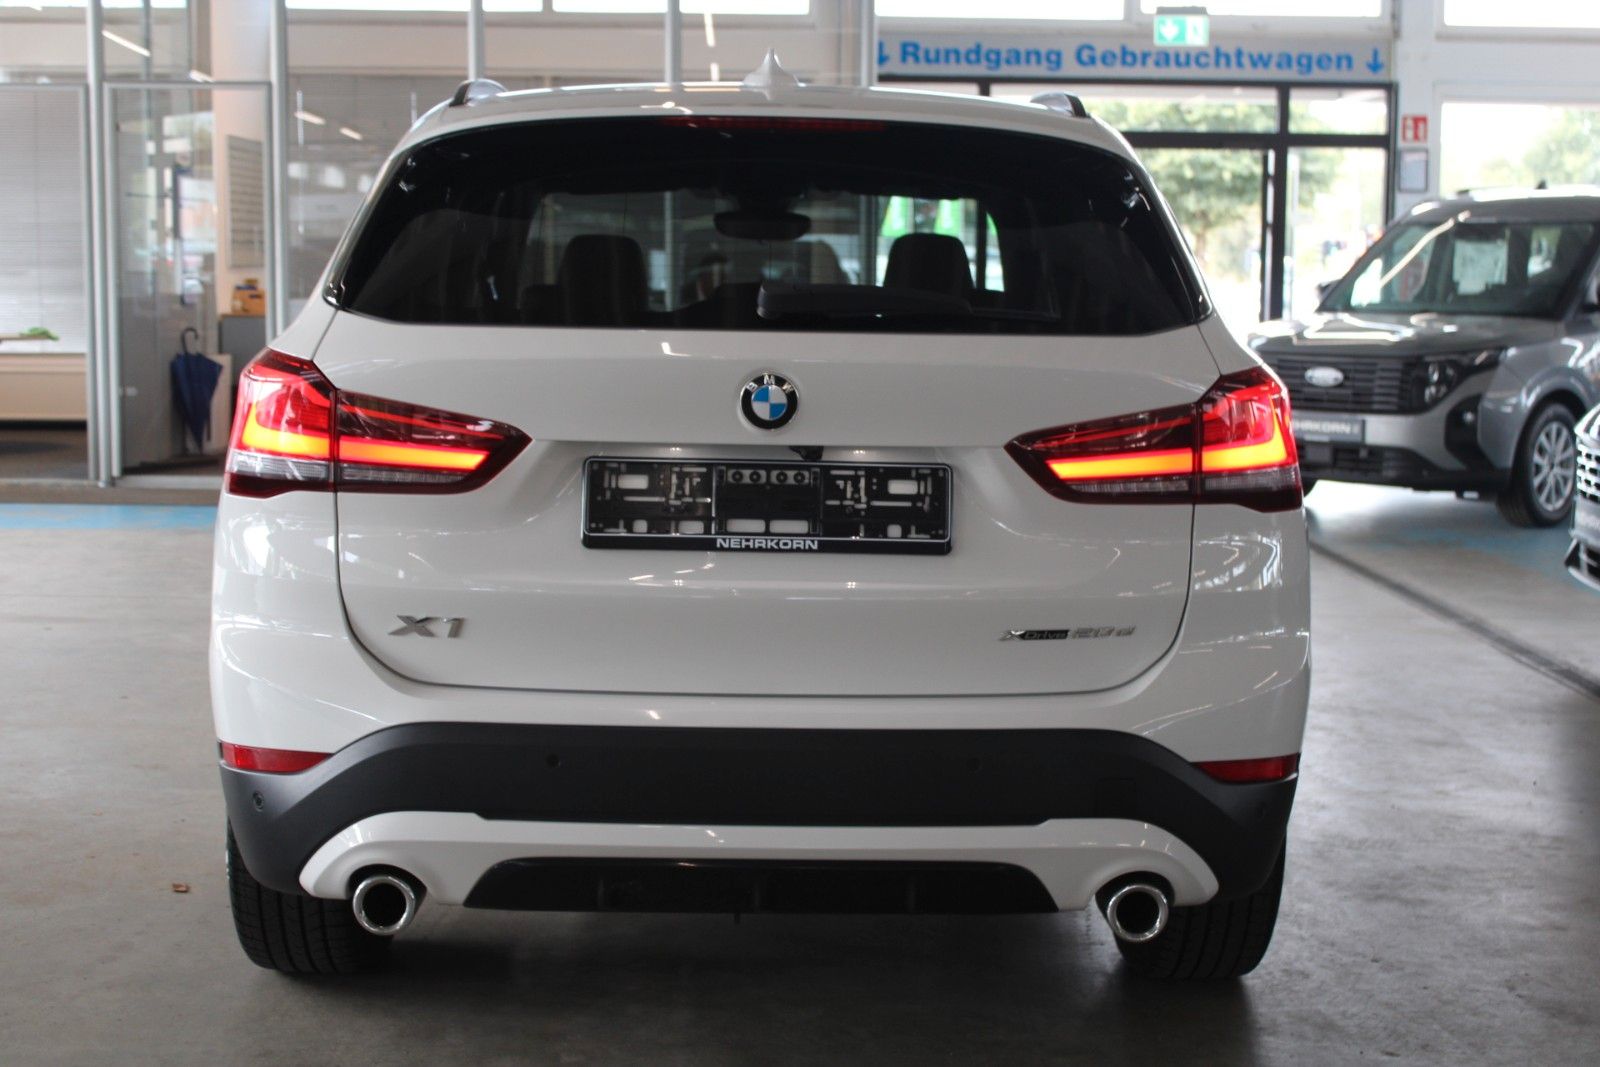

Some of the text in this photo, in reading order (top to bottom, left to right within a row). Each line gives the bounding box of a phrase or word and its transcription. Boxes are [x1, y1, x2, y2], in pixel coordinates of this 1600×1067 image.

[900, 41, 1354, 75] Rundgang Gebrauchtwagen
[747, 373, 793, 393] BMW
[716, 537, 818, 550] NEHRKORN
[388, 614, 466, 638] X1
